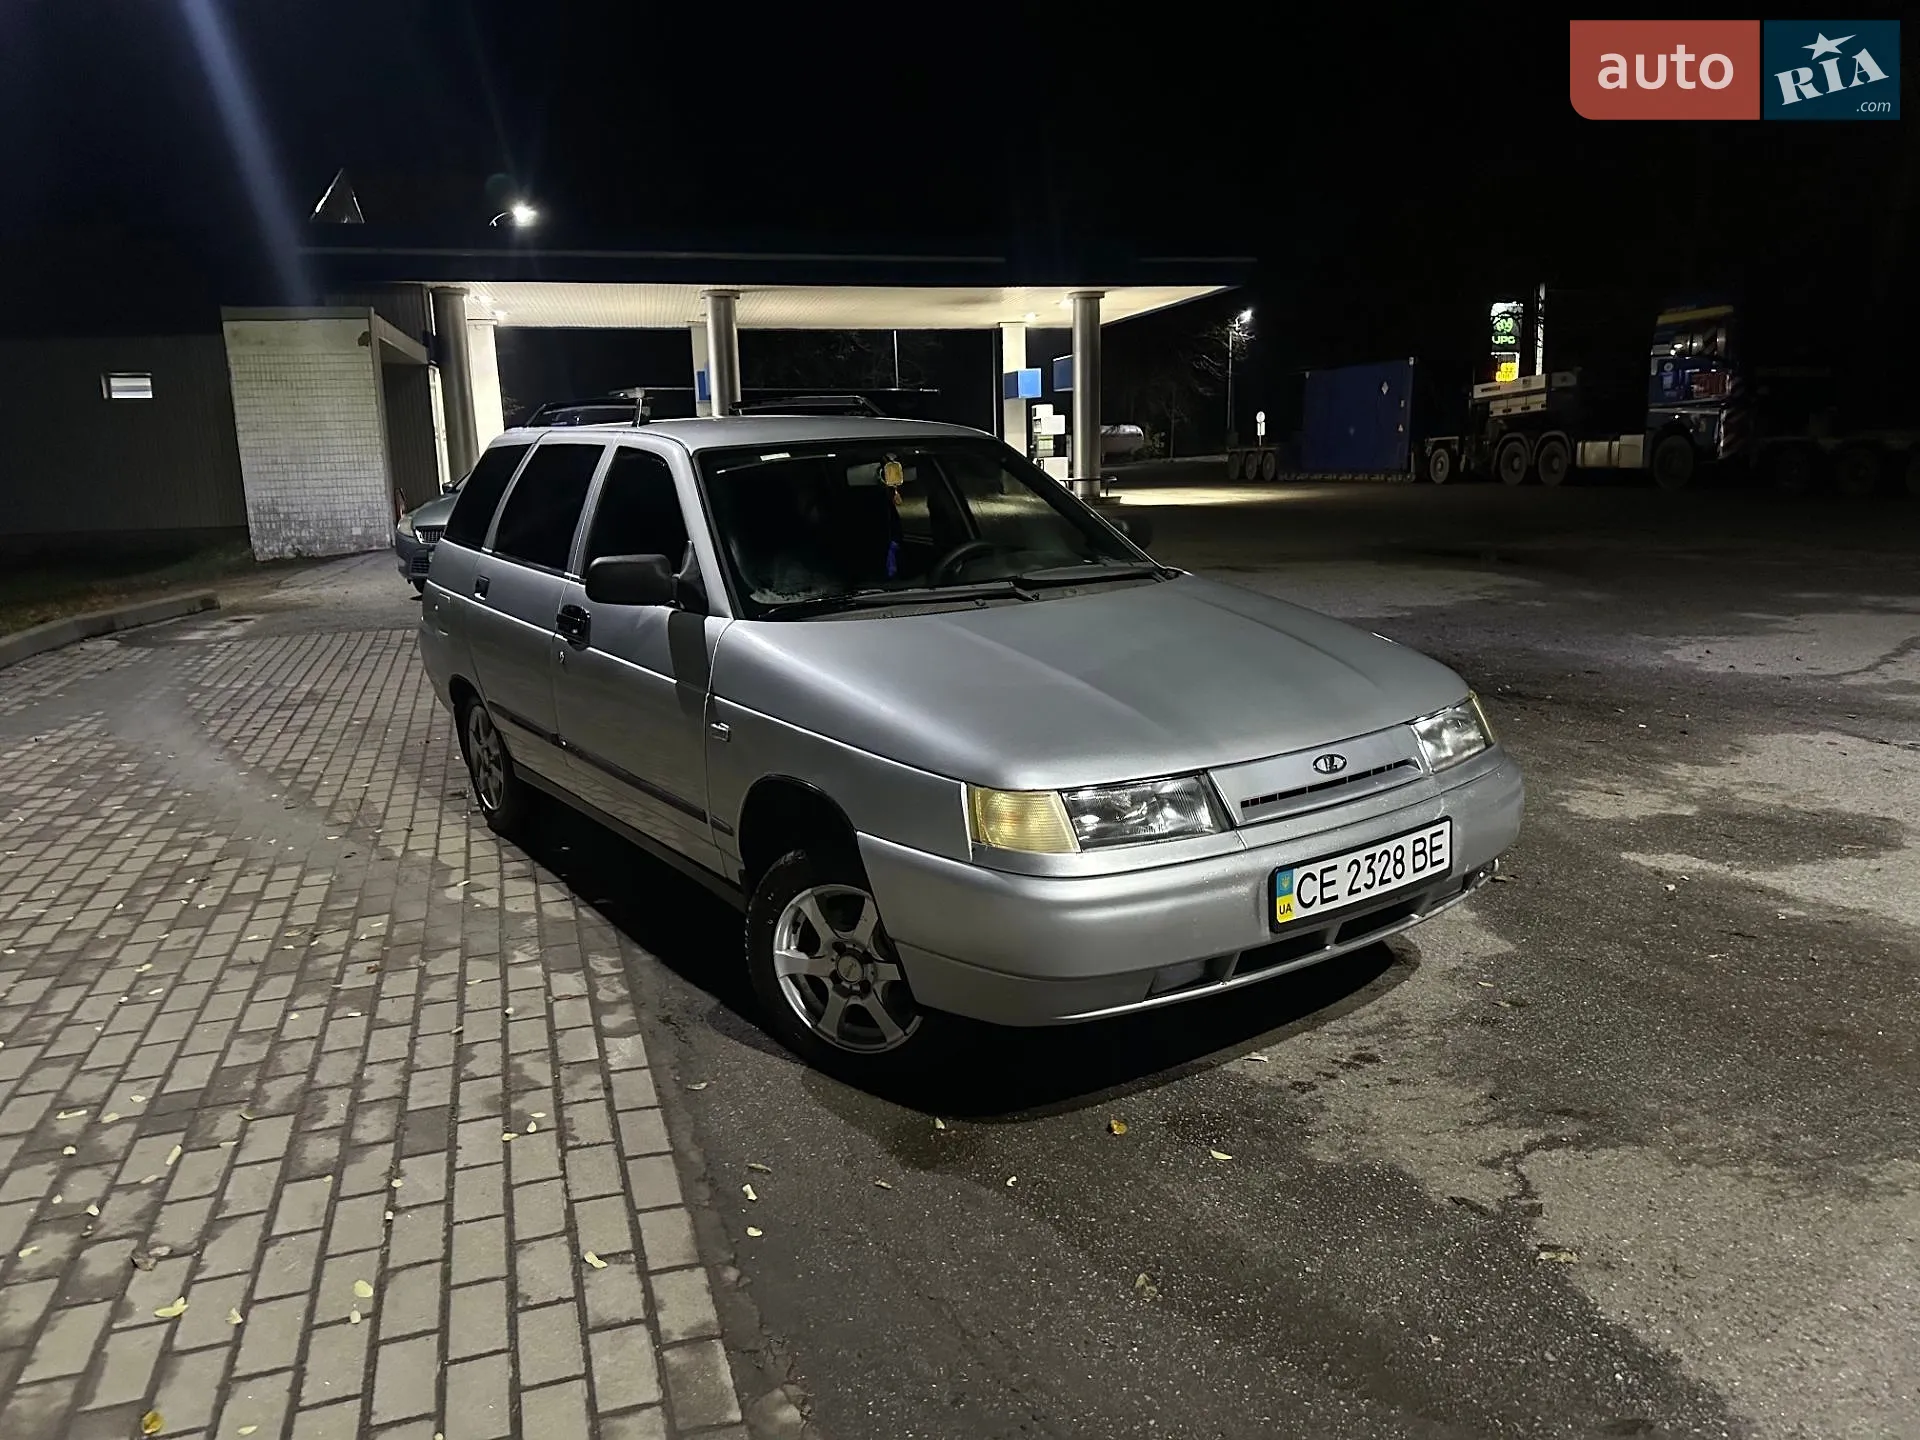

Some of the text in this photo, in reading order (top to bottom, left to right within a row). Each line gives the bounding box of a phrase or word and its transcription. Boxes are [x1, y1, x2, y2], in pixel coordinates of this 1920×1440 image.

[1491, 335, 1516, 345] UPG
[1296, 829, 1446, 909] CE 2328 BE
[1279, 904, 1293, 915] UA
